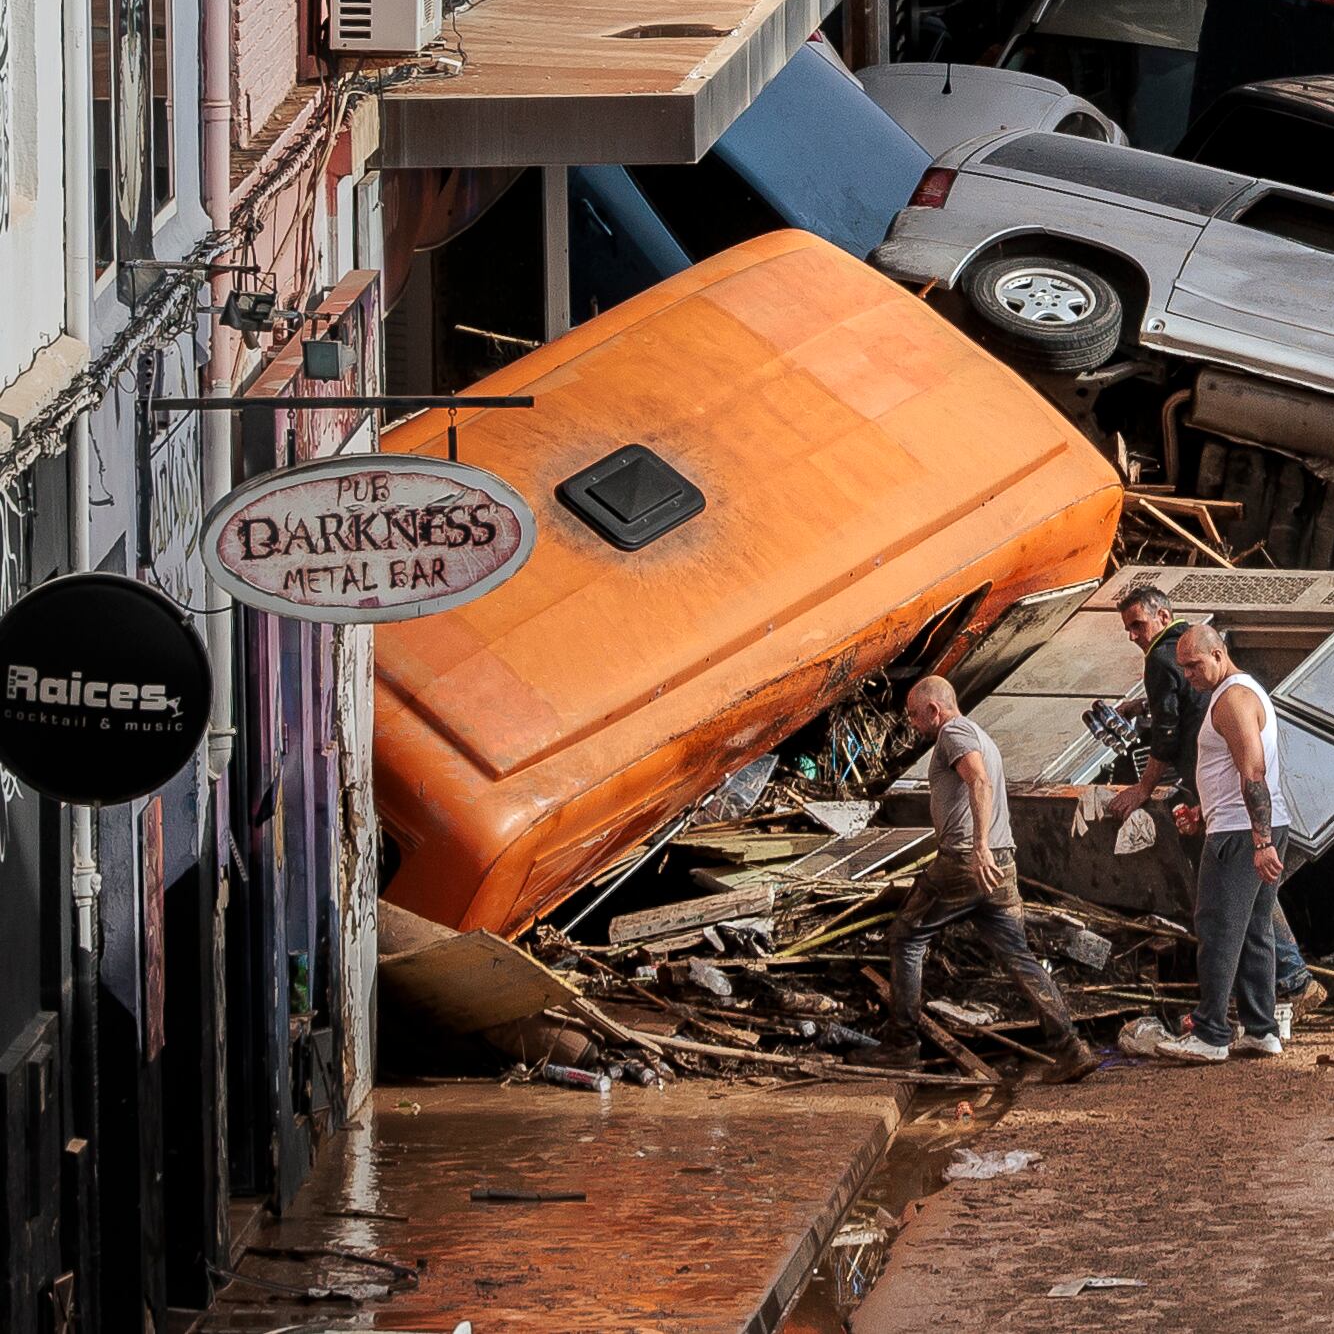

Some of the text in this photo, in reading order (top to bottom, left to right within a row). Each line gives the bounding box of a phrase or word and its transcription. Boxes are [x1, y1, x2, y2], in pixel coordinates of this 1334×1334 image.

[336, 474, 391, 505] PUB
[236, 504, 499, 561] DARKNESS
[283, 559, 450, 598] METAL BAR
[6, 664, 168, 711] Raices
[3, 709, 87, 728] cocktail
[124, 720, 184, 732] music
